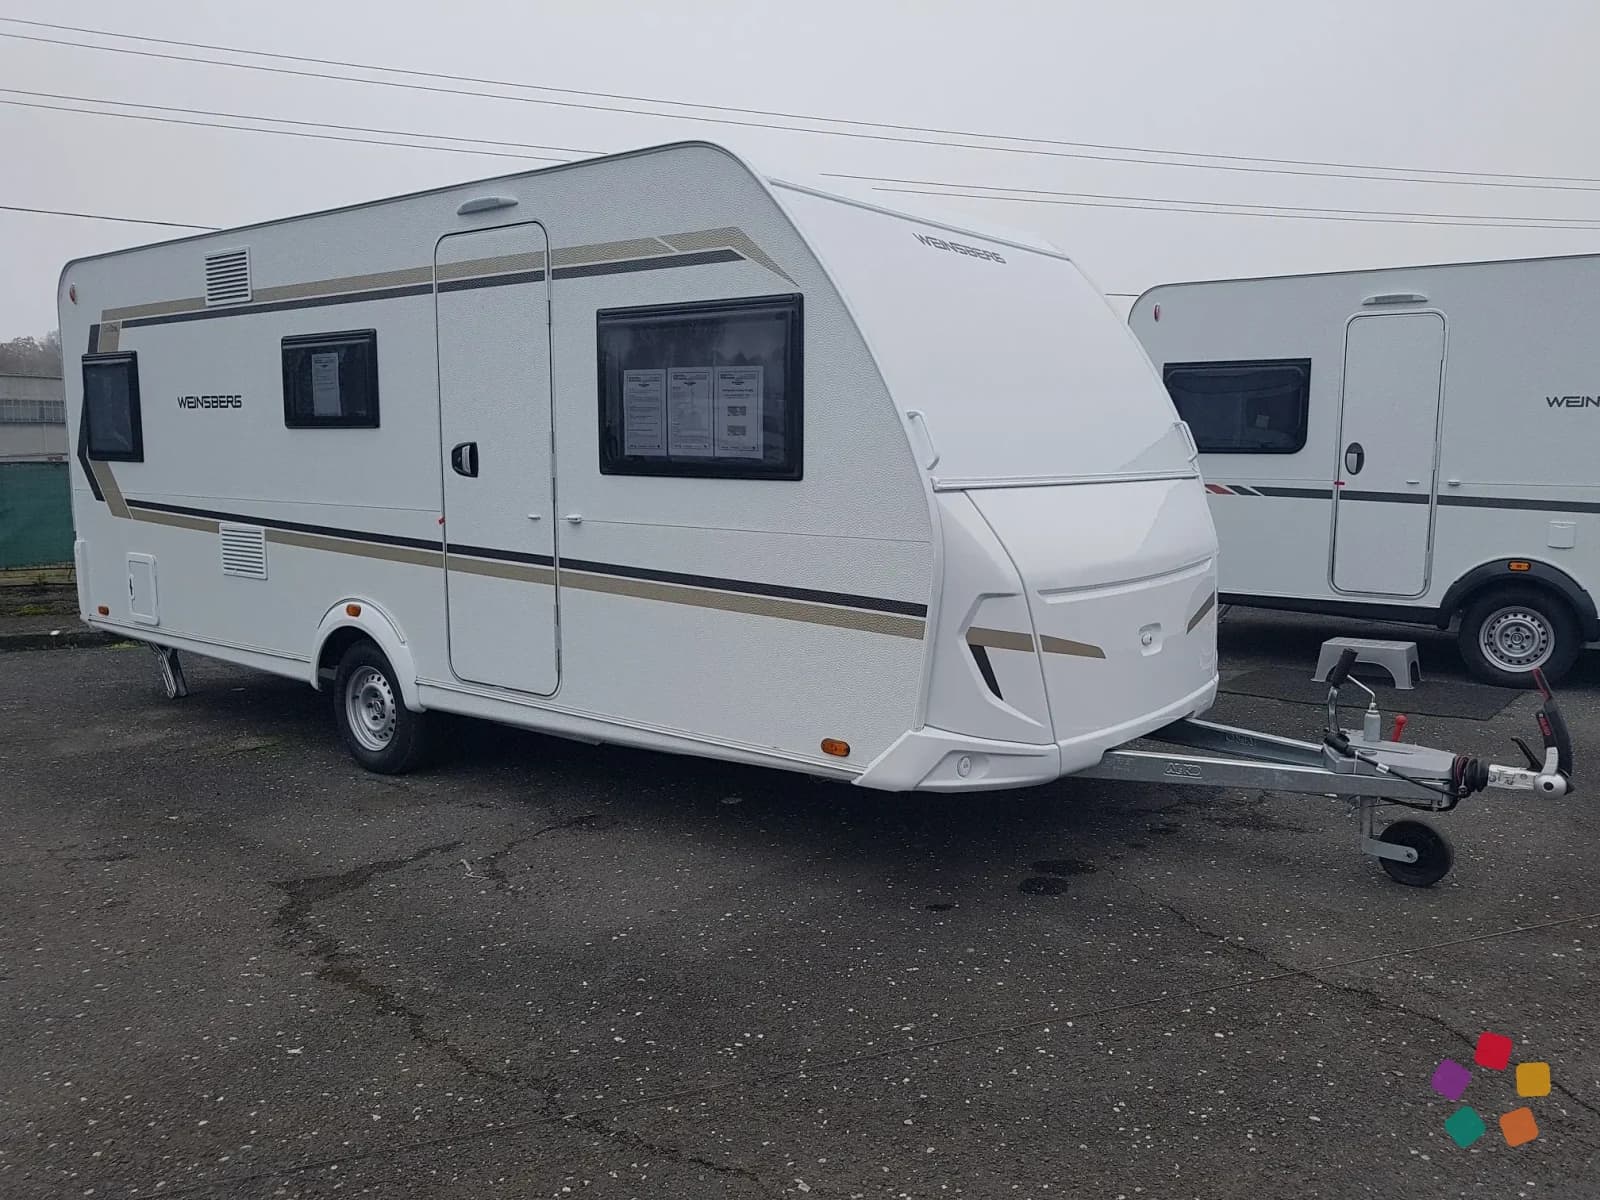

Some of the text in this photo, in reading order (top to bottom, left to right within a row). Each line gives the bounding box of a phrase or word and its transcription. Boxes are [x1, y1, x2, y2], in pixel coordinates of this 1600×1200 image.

[912, 232, 1007, 264] WEINSBERG
[177, 395, 242, 409] WEINSBERG
[1546, 396, 1600, 408] WEIN
